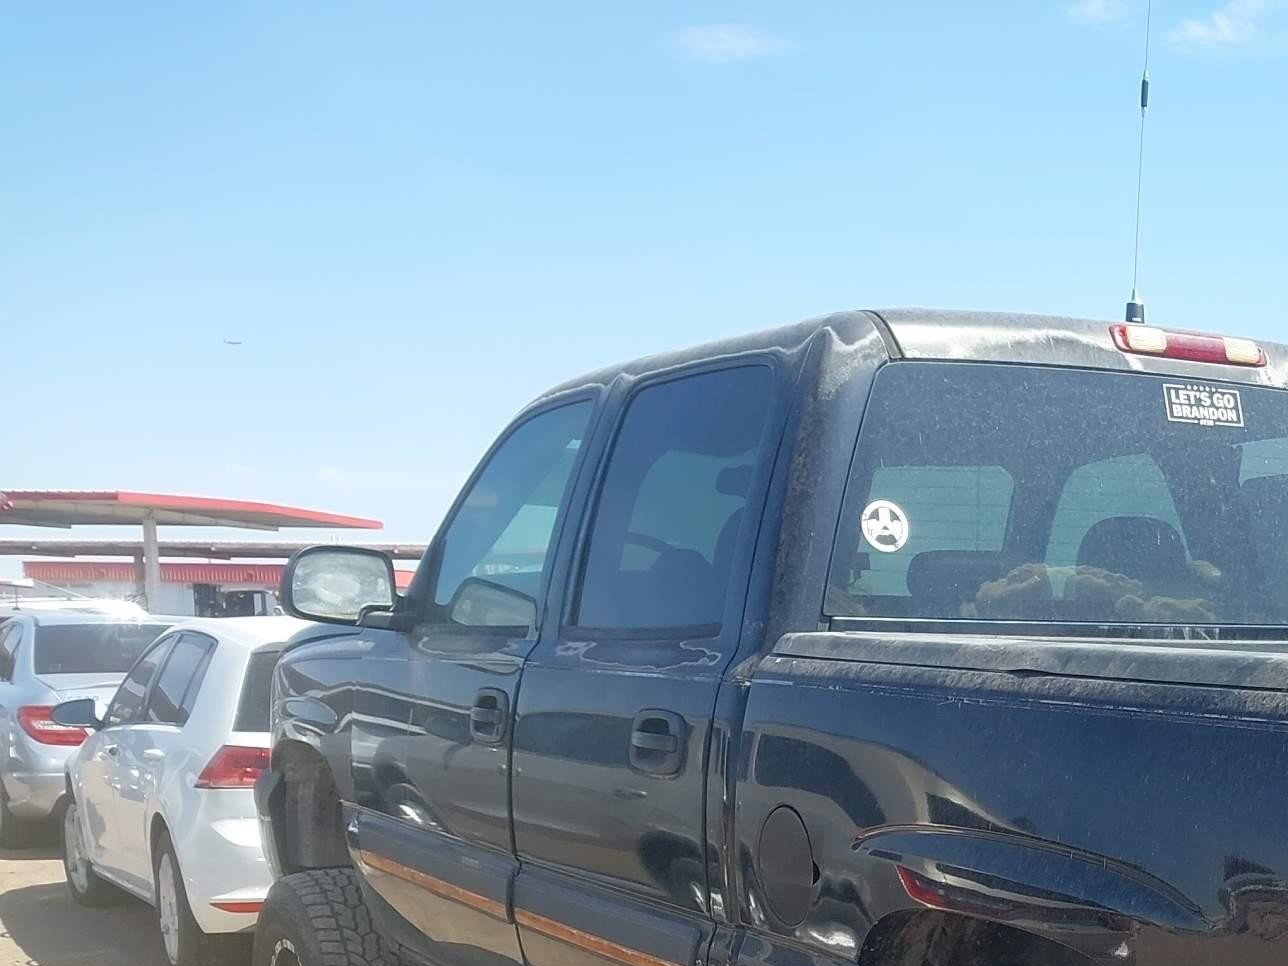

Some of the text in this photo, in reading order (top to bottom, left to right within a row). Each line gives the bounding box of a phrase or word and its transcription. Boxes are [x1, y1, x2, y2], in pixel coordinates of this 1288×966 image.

[1170, 389, 1235, 408] LET'S GO
[1172, 404, 1237, 421] BRANDON
